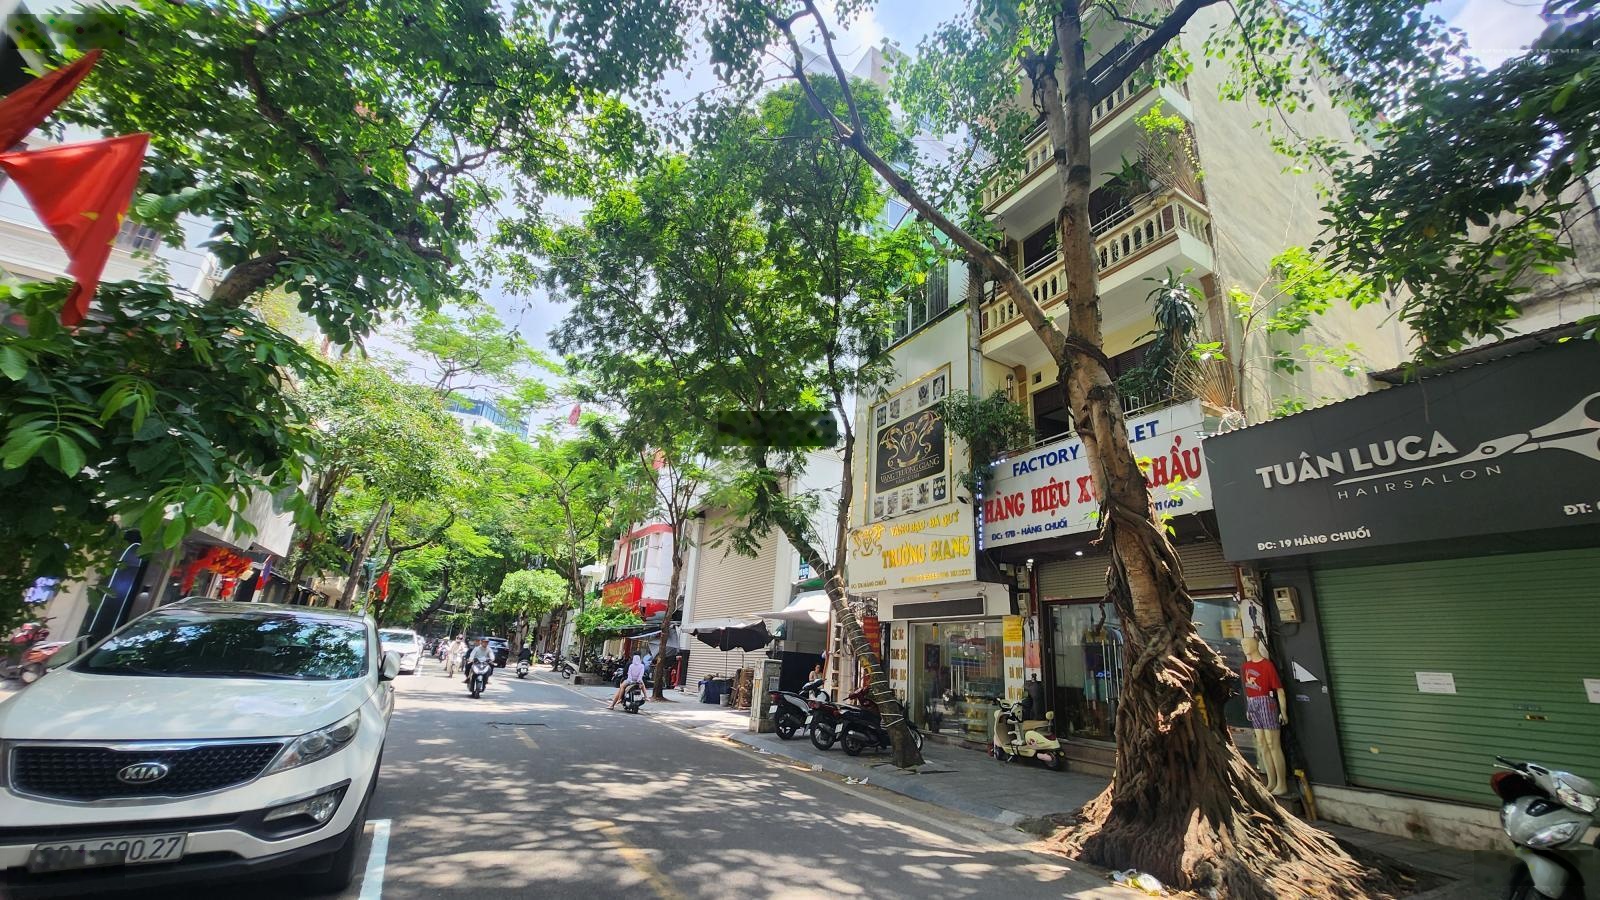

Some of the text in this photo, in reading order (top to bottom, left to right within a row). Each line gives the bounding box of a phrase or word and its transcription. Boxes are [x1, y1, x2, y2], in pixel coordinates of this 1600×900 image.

[1012, 444, 1081, 477] FACTORY
[1255, 430, 1459, 489] TUÂN LUCA
[984, 490, 1024, 524] HÀNG
[1031, 477, 1071, 516] HIỆU
[1140, 435, 1202, 488] HẨU
[1337, 464, 1502, 500] HAIRSALON
[1563, 503, 1593, 516] ĐT:
[1021, 524, 1043, 535] HÀNG
[1044, 517, 1068, 532] CHUỐI
[1257, 525, 1371, 551] ĐC: 19 HÀNG CHUỐI
[929, 535, 971, 561] GIANG
[124, 767, 159, 780] KIA
